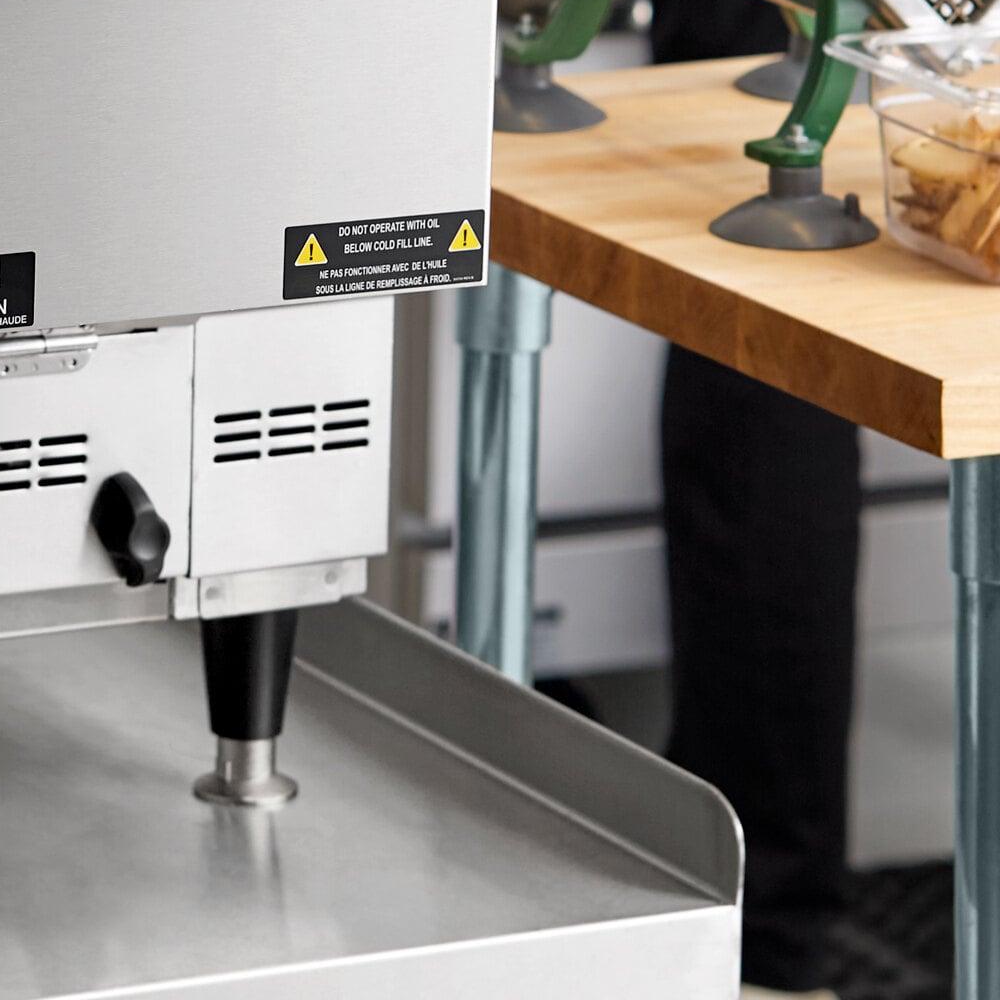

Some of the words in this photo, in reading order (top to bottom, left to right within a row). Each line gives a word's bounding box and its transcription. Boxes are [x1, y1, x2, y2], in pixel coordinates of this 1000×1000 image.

[338, 226, 350, 237] DO
[351, 224, 368, 236] NOT
[369, 221, 405, 235] OPERATE
[406, 219, 426, 230] WITH
[427, 218, 440, 229] OIL
[344, 241, 372, 254] BELOW
[373, 239, 395, 251] COLD
[396, 237, 413, 249] FILL
[413, 236, 433, 249] LINE.
[319, 269, 329, 280] NE
[329, 267, 343, 278] PAS
[343, 263, 391, 278] FONCTIONNER
[391, 262, 409, 273] AVEC
[411, 261, 421, 271] DE
[422, 258, 448, 270] L'HUILE
[315, 284, 334, 295] SOUS
[335, 282, 345, 293] LA
[345, 280, 364, 292] LIGNE
[365, 279, 375, 290] DE
[376, 275, 422, 289] REMPLISSAGE
[423, 273, 430, 284] À
[430, 272, 451, 284] FROID.
